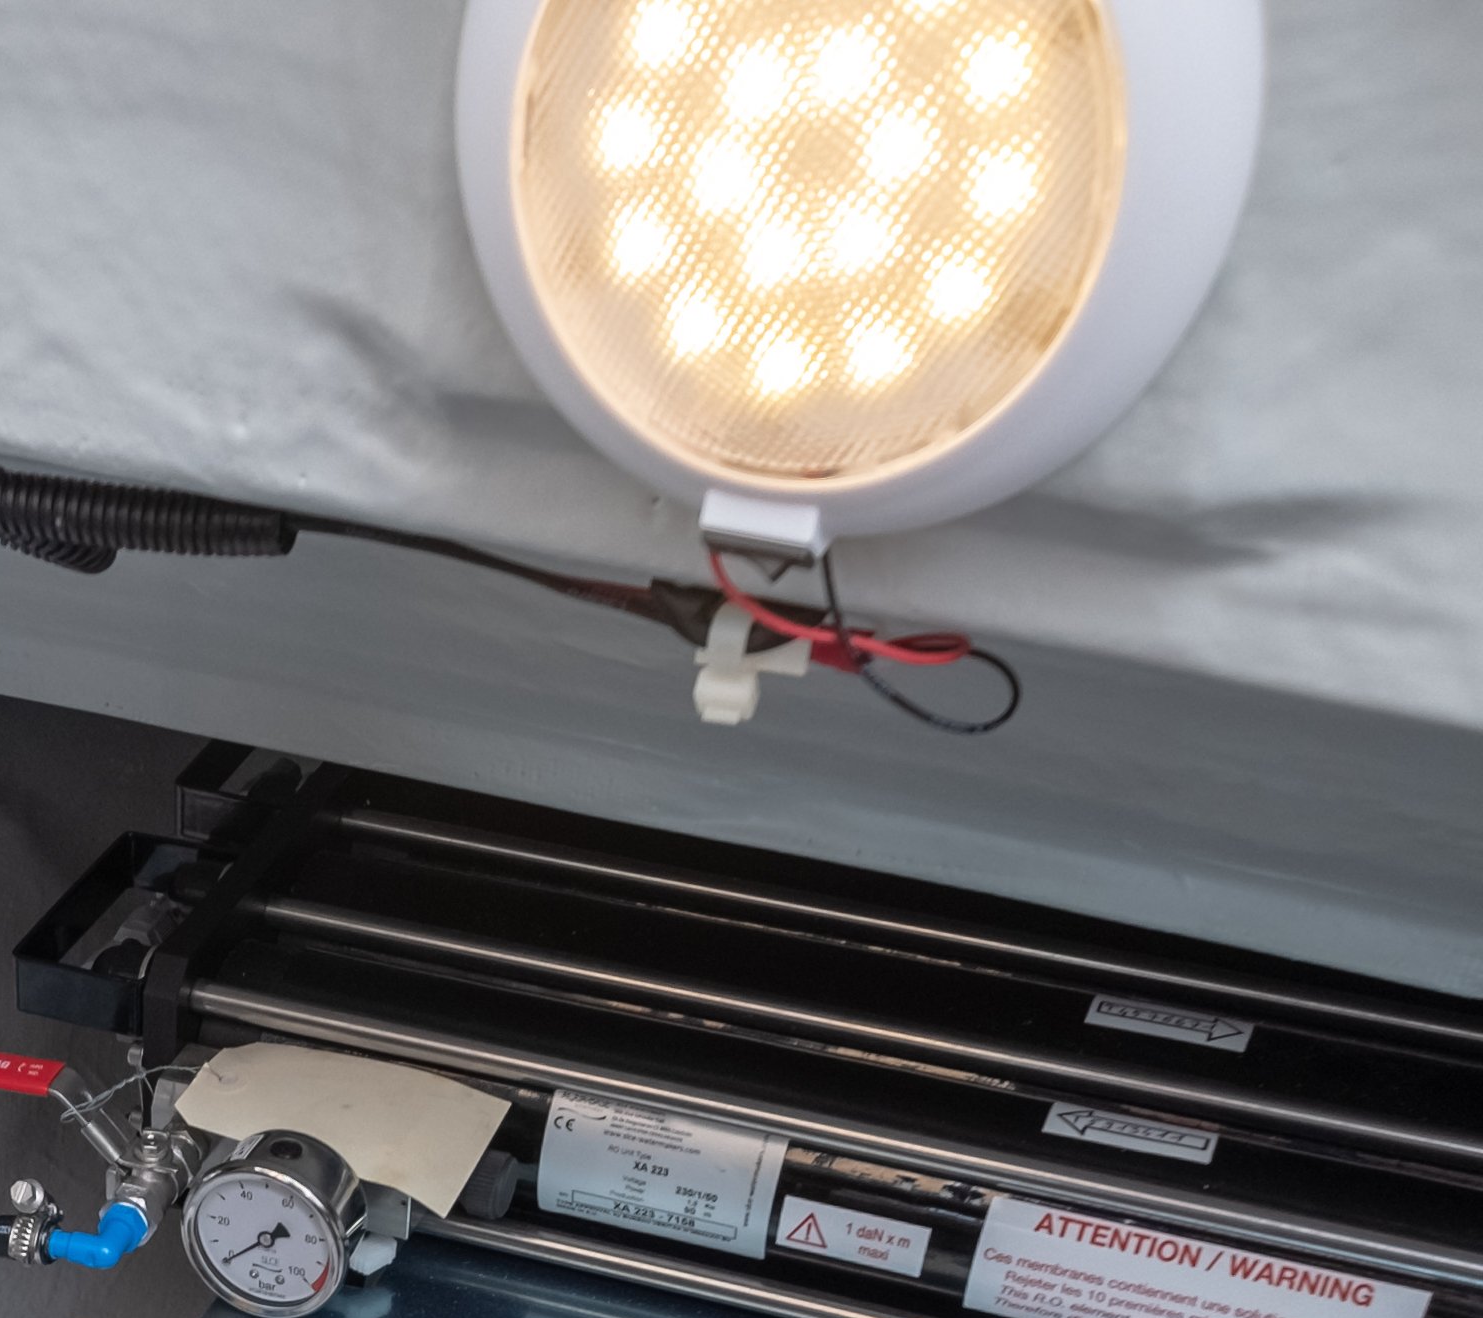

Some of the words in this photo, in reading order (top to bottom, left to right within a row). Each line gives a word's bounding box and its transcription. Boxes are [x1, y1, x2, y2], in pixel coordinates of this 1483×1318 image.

[632, 1161, 648, 1172] XA
[650, 1165, 669, 1177] 223
[241, 1191, 253, 1200] 40
[282, 1198, 294, 1209] 60
[612, 1200, 631, 1213] XA
[634, 1206, 655, 1219] 223
[218, 1216, 230, 1226] 20
[305, 1235, 317, 1245] 80
[844, 1222, 853, 1234] 1
[855, 1225, 884, 1242] daN
[885, 1234, 894, 1245] x
[896, 1236, 911, 1248] m
[857, 1244, 890, 1261] maxi
[1033, 1209, 1203, 1269] ATTENTION
[1204, 1249, 1222, 1273] /
[1226, 1254, 1376, 1309] WARNING
[288, 1266, 305, 1277] 100
[258, 1280, 276, 1291] bar
[981, 1247, 1013, 1265] Ces
[1015, 1254, 1105, 1287] membranes
[1106, 1275, 1198, 1308] contiennent
[1200, 1299, 1230, 1316] une
[1003, 1270, 1058, 1294] Rejeter
[1059, 1283, 1082, 1299] les
[1086, 1289, 1106, 1304] 10
[999, 1284, 1030, 1301] This
